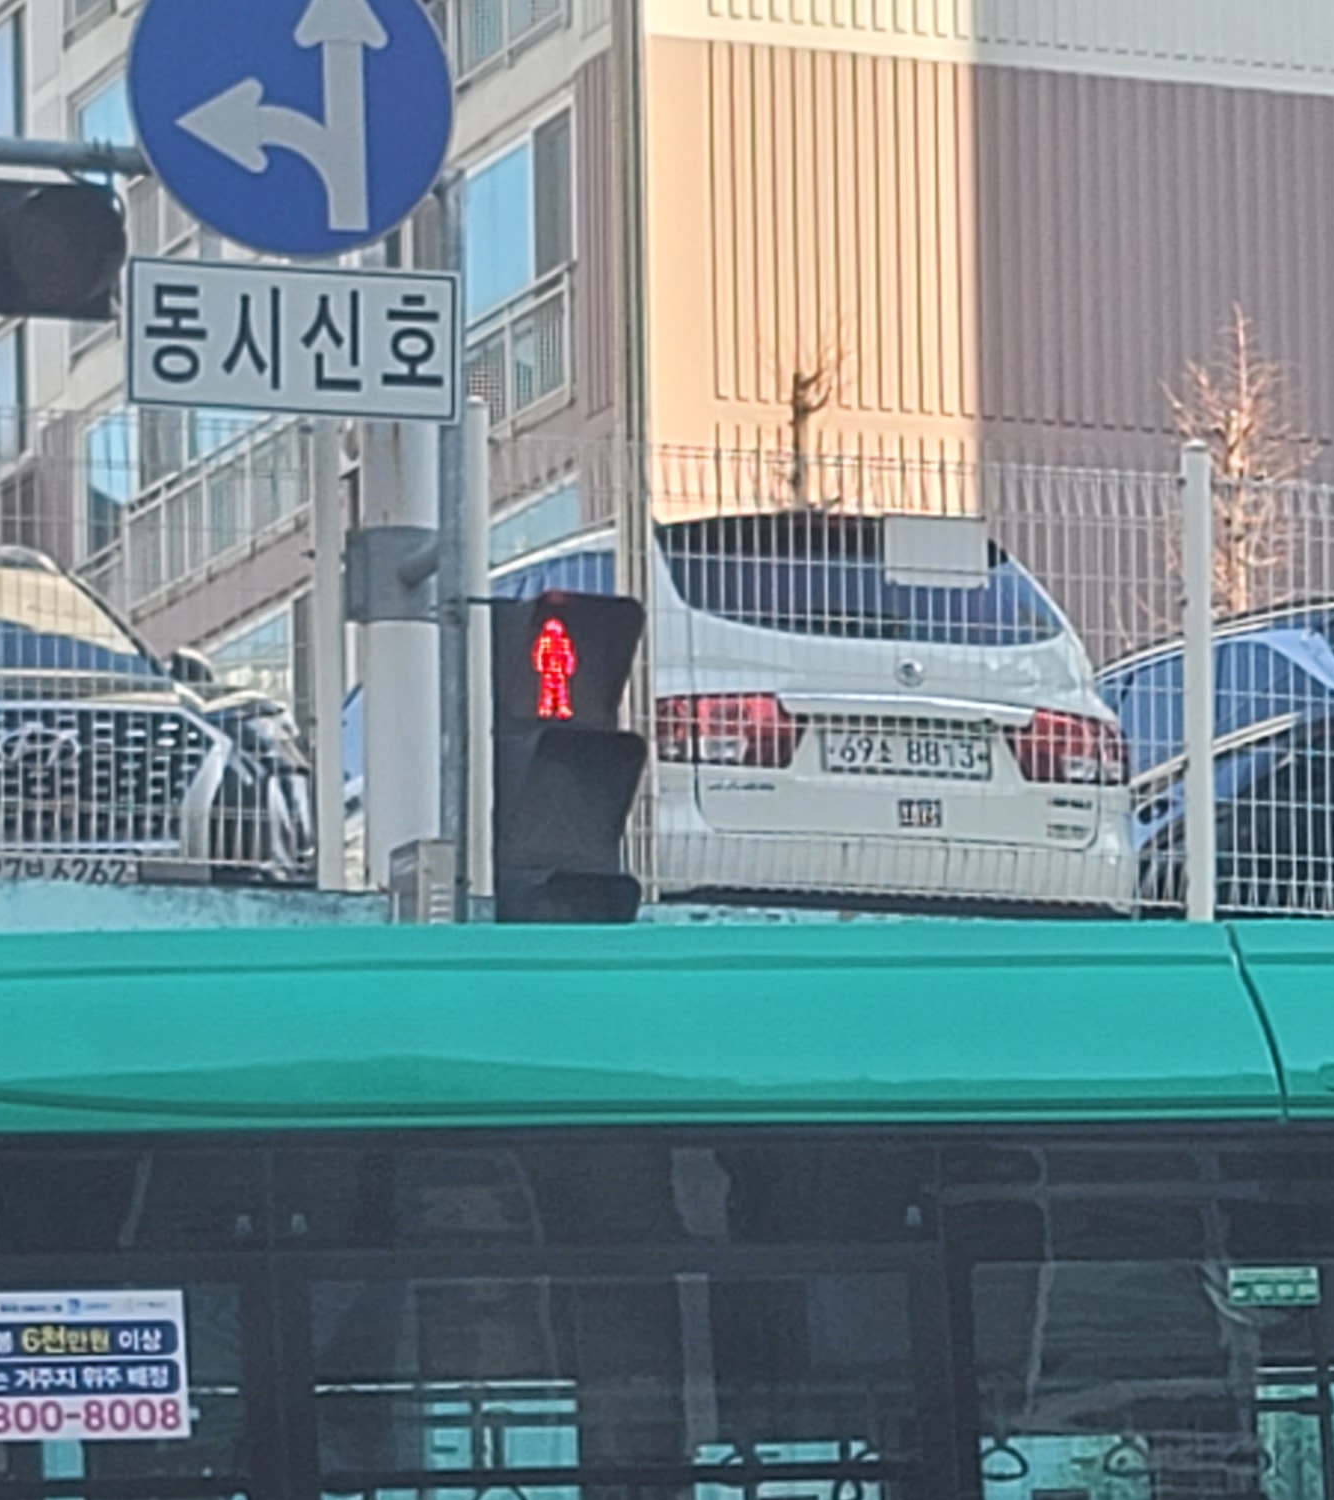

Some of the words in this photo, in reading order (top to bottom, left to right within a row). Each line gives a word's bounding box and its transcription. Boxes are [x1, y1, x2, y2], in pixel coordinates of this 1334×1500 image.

[145, 282, 444, 392] 동시신호
[21, 1325, 111, 1354] 6천만원
[119, 1328, 162, 1352] 이상
[14, 1366, 77, 1390] 거주지
[80, 1365, 123, 1389] 위주
